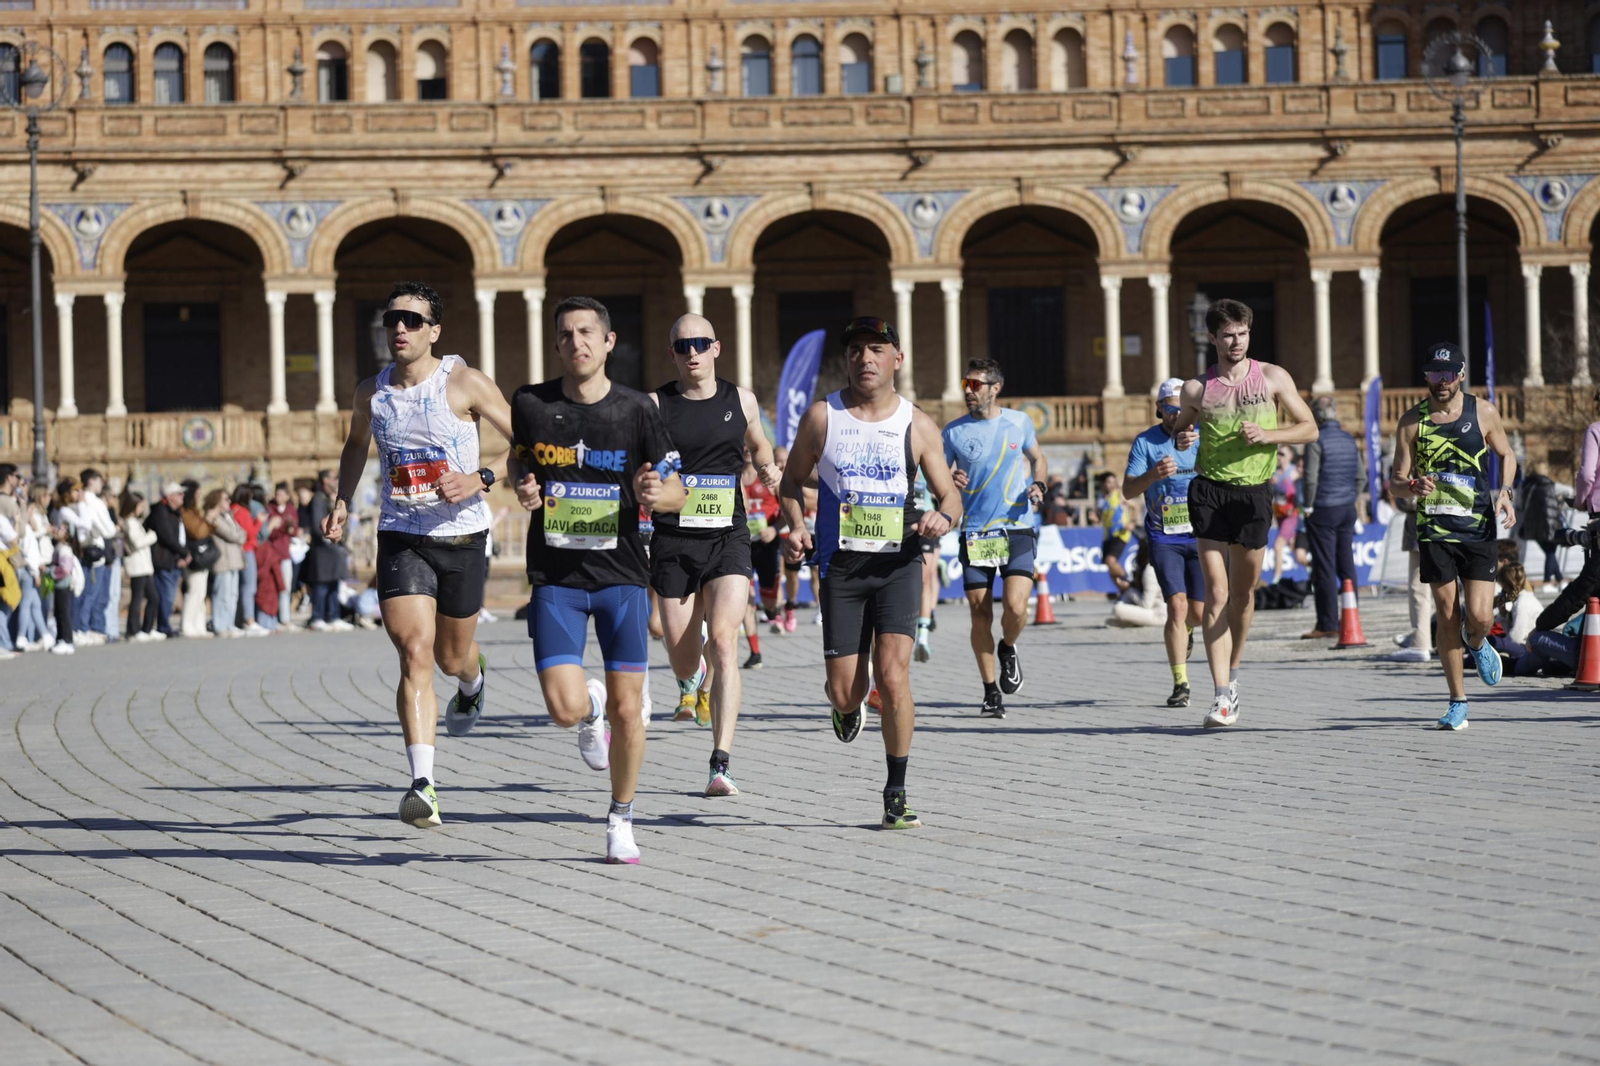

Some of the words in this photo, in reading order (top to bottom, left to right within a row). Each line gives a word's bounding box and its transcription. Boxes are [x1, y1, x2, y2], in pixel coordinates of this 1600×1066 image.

[533, 442, 576, 467] CORRE
[836, 443, 900, 457] RUNNERS
[404, 450, 438, 461] ZURICH
[408, 469, 426, 478] 1128
[700, 478, 730, 486] ZURICH
[1441, 475, 1469, 485] ZURICH
[392, 485, 417, 494] NACHO
[570, 486, 611, 497] ZURICH
[701, 493, 718, 501] 2468
[570, 506, 592, 515] 2020
[695, 503, 722, 515] ALEX
[863, 513, 881, 521] 1948
[545, 520, 570, 532] JAVI
[573, 522, 617, 534] ESTACA
[855, 523, 886, 537] RAÚL
